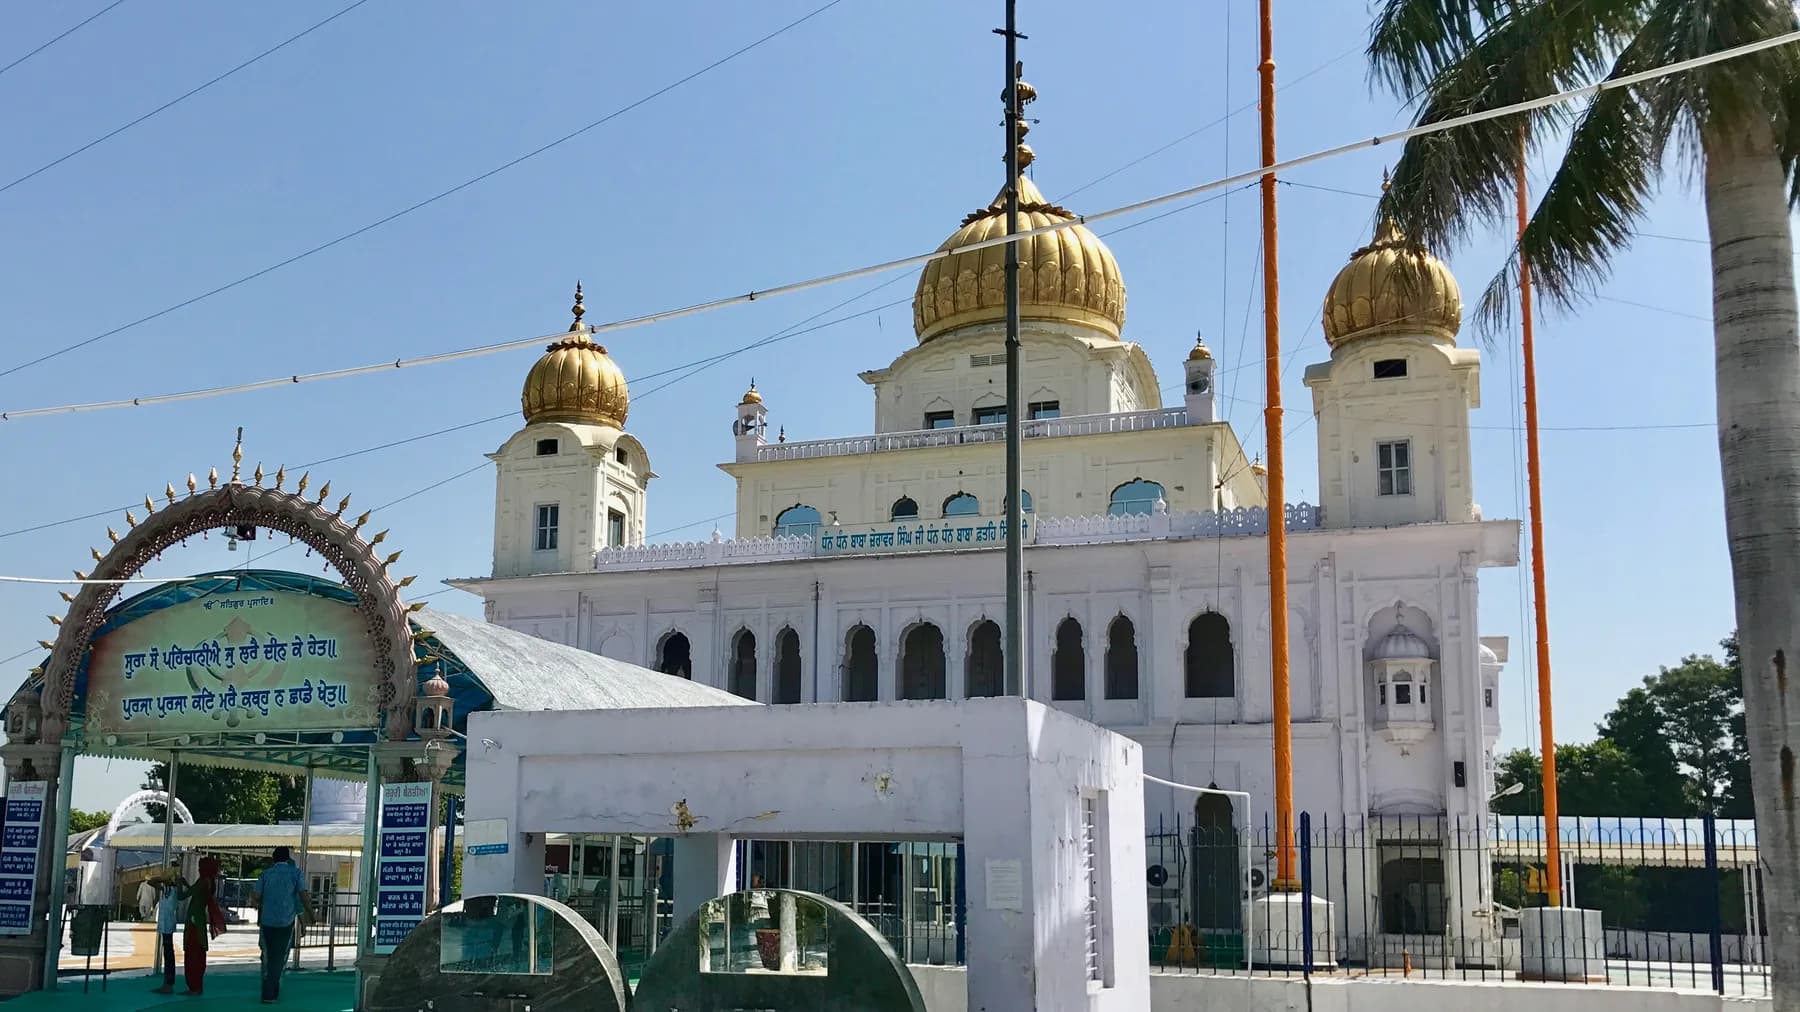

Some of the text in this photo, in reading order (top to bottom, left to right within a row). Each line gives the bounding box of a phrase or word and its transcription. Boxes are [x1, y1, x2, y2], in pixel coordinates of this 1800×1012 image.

[822, 530, 833, 549] ਧੰਨ
[836, 529, 848, 549] ਧੰਨ
[850, 533, 867, 548] ਬਾਬਾ
[897, 525, 912, 545] ਸਿੰਘ
[915, 524, 924, 544] ਜੀ
[927, 523, 939, 544] ਧੰਨ
[942, 522, 954, 542] ਧੰਨ
[956, 527, 973, 542] ਬਾਬਾ
[220, 598, 244, 610] ਸਤਿਗੁਰ
[124, 653, 146, 679] ਸੂਰਾ
[163, 640, 221, 669] ਪਹਿਚਾਨੀਐ
[225, 646, 235, 669] ਜੁ
[239, 637, 259, 664] ਲਰੈ
[263, 637, 288, 662] ਦੀਨ
[292, 635, 303, 658] ਕੇ
[123, 697, 153, 720] ਪੁਰਜਾ
[157, 695, 188, 718] ਪੁਰਜਾ
[192, 686, 215, 713] ਕਟਿ
[219, 684, 237, 711] ਮਰੈ
[241, 689, 271, 716] ਕਬਹੂ
[274, 688, 285, 707] ਨ
[289, 679, 313, 704] ਛਾਡੈ
